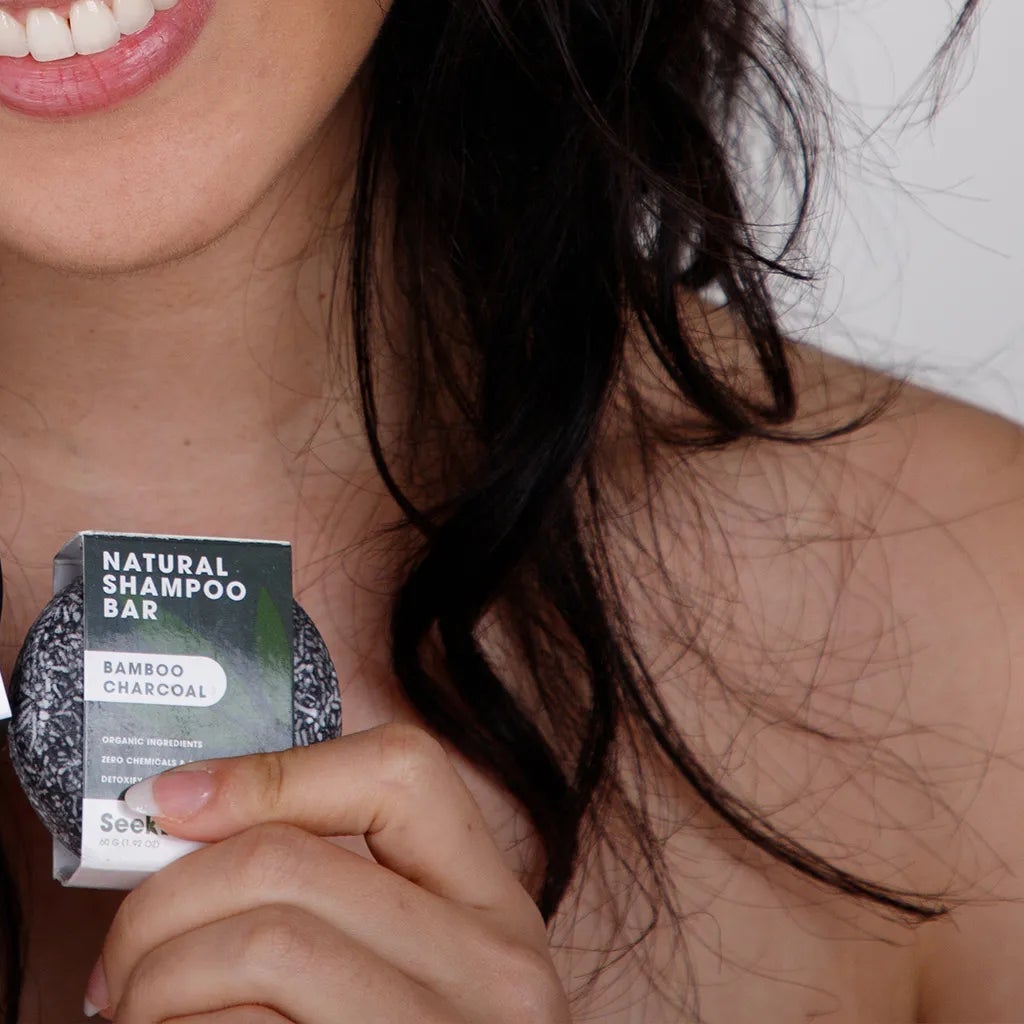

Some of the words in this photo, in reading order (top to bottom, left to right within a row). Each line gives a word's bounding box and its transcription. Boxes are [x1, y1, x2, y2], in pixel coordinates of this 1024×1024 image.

[103, 551, 229, 576] NATURAL
[103, 574, 247, 601] SHAMPOO
[103, 599, 158, 620] BAR
[103, 660, 184, 677] BAMBOO
[103, 680, 207, 699] CHARCOAL
[102, 736, 144, 745] ORGANIC
[146, 738, 203, 749] INGREDIENTS
[101, 756, 124, 764] ZERO
[126, 757, 176, 766] CHEMICALS
[101, 775, 143, 785] DETOXIFY
[100, 813, 168, 836] Seek
